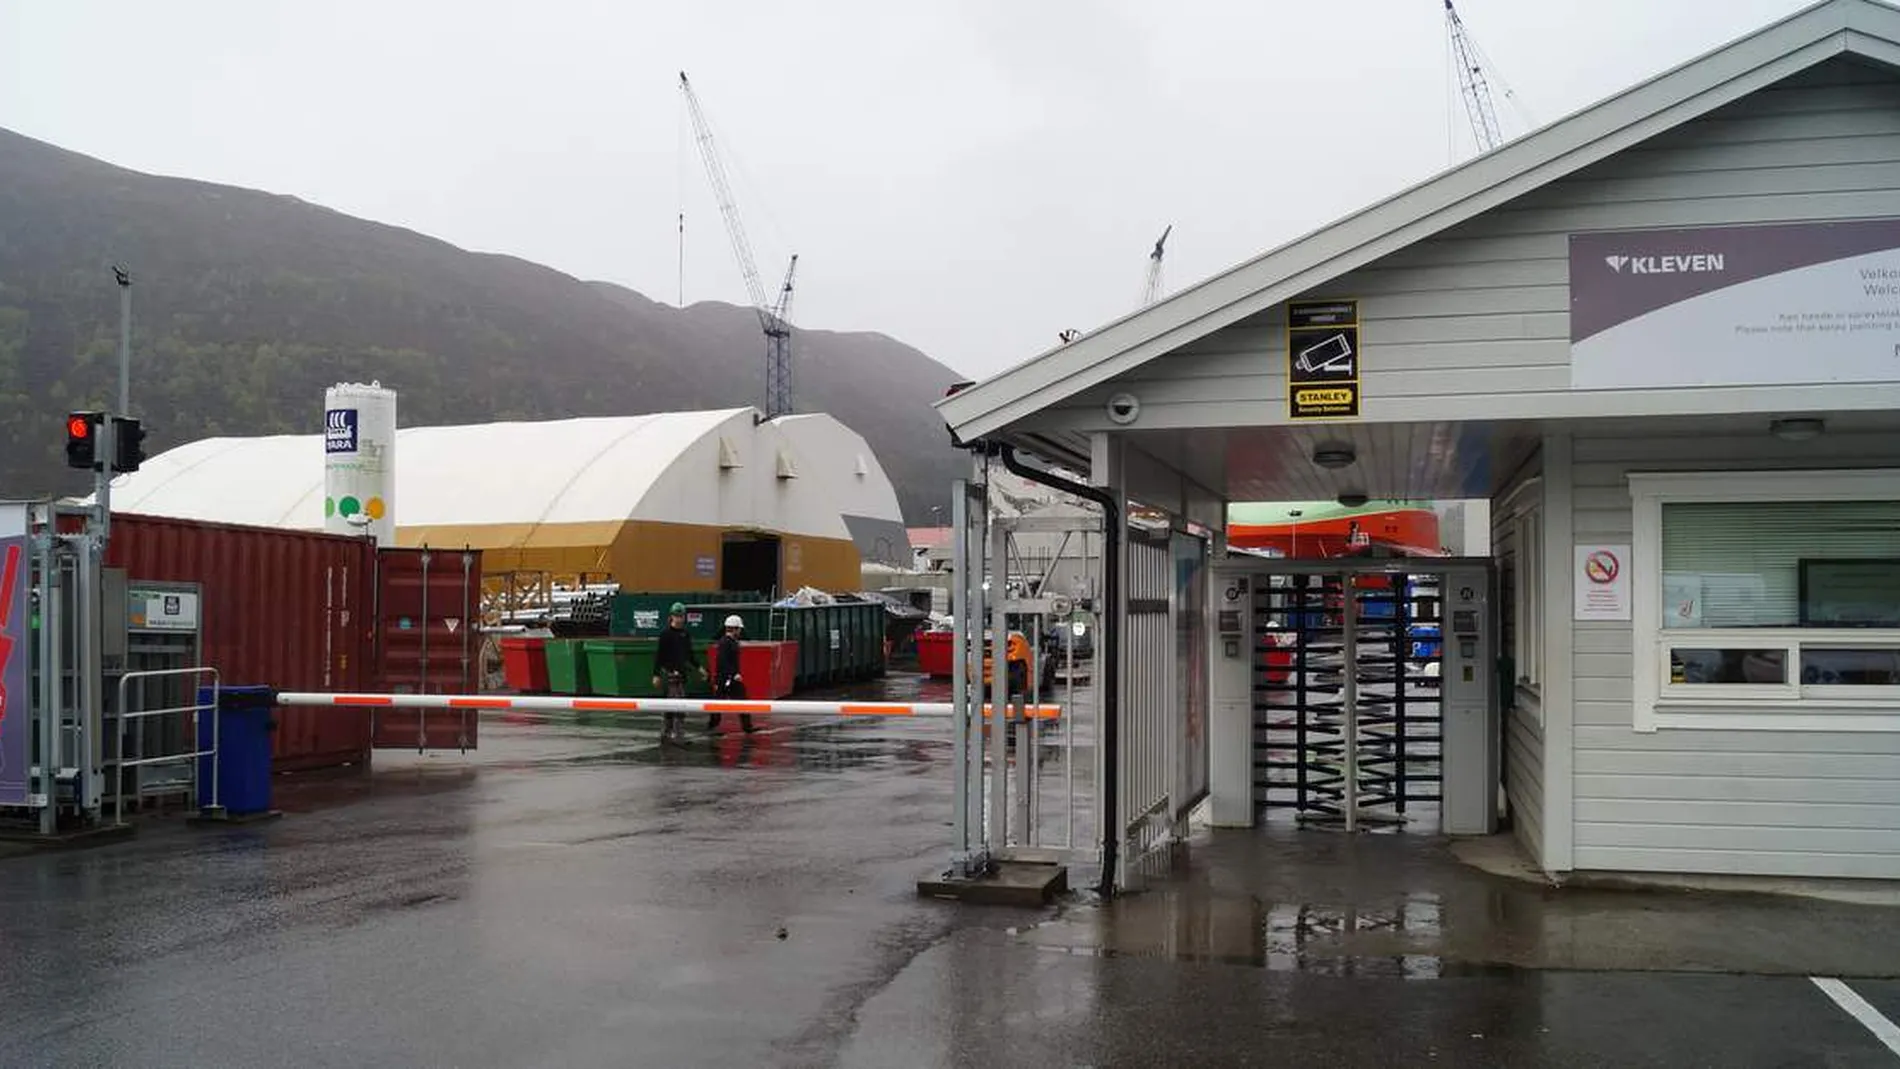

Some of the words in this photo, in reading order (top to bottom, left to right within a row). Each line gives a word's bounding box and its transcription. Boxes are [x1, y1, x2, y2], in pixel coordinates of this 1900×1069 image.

[1632, 254, 1724, 274] KLEVEN
[1860, 268, 1900, 279] Velko
[1863, 284, 1900, 296] Welc
[1300, 392, 1347, 402] STANLEY
